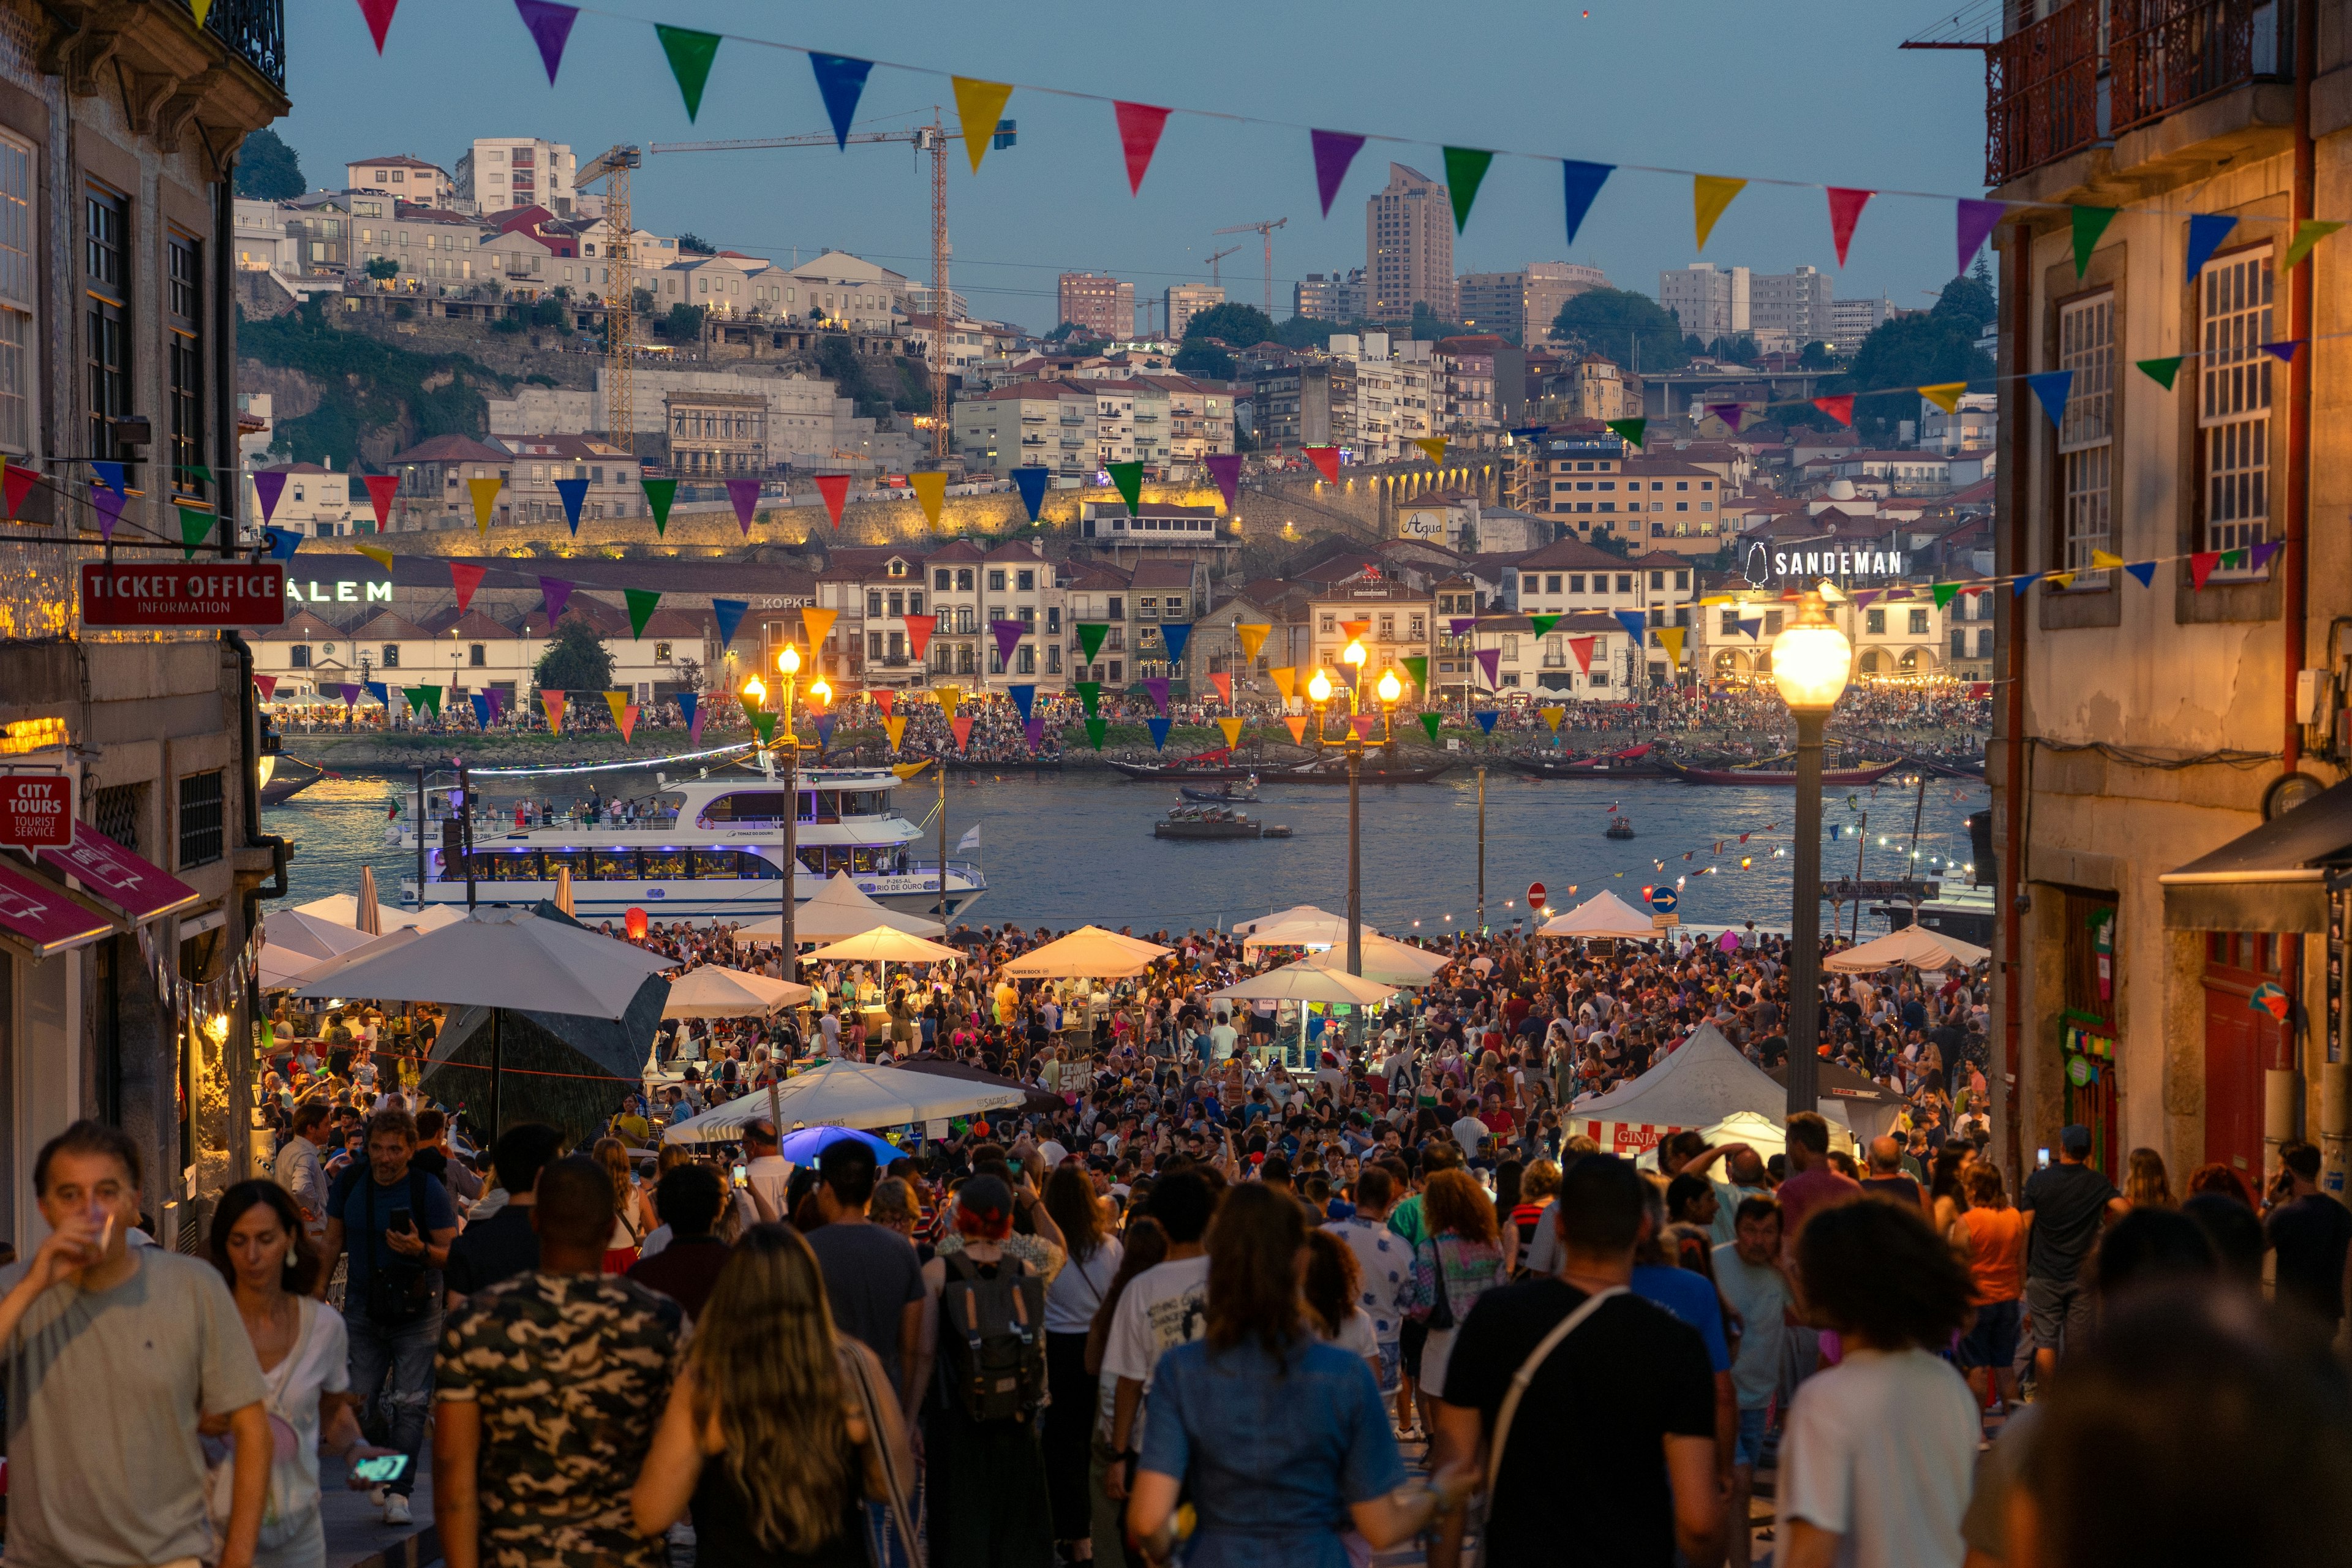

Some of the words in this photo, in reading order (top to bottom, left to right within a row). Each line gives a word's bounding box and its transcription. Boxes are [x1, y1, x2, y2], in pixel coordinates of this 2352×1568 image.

[1401, 511, 1442, 540] Água
[1775, 552, 1901, 575] SANDEMAN
[91, 576, 178, 598] TICKET
[189, 575, 276, 598] OFFICE
[138, 601, 230, 613] INFORMATION
[763, 598, 812, 608] KOPKE
[17, 784, 52, 797] CITY
[9, 799, 62, 813] TOURS
[15, 816, 56, 827] TOURIST
[15, 827, 55, 837] SERVICE
[1060, 1072, 1092, 1091] SHOT
[984, 1096, 1008, 1107] SAGRES
[820, 1118, 845, 1127] SGRES
[1618, 1131, 1659, 1147] GINJA
